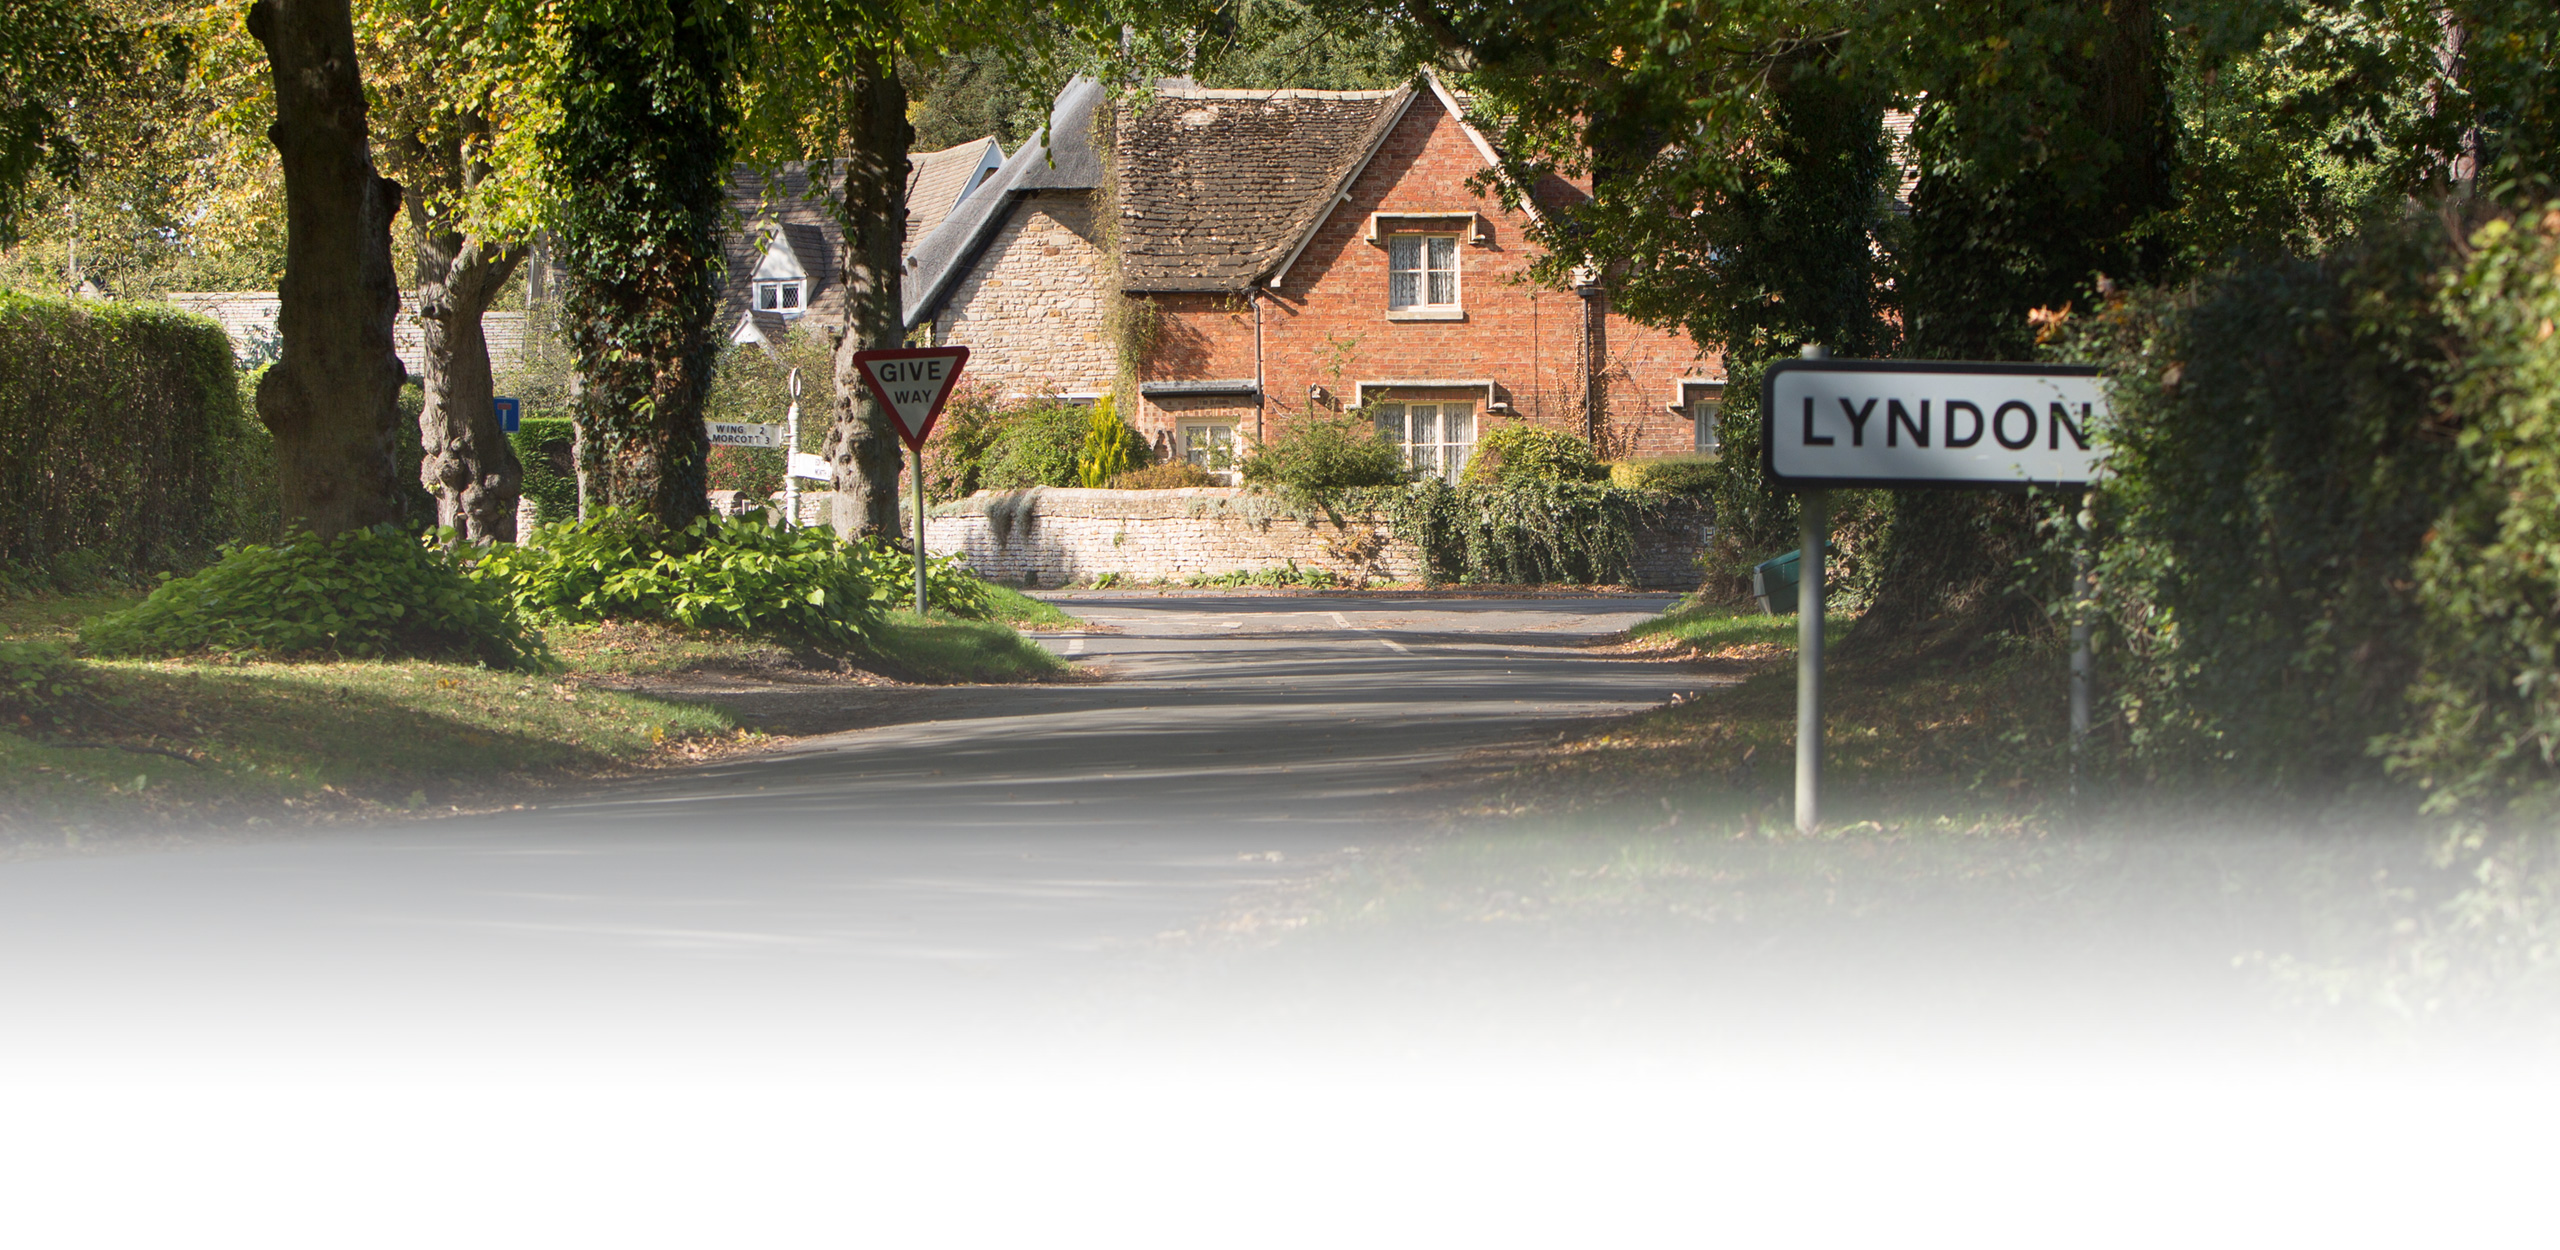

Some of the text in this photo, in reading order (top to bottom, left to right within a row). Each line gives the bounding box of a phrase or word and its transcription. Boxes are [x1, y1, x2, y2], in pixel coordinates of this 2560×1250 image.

[880, 361, 941, 382] GIVE
[894, 389, 932, 404] WAY
[715, 425, 765, 435] WING 2
[1803, 397, 2092, 451] LYNDON
[712, 434, 770, 445] MORCOTT 3
